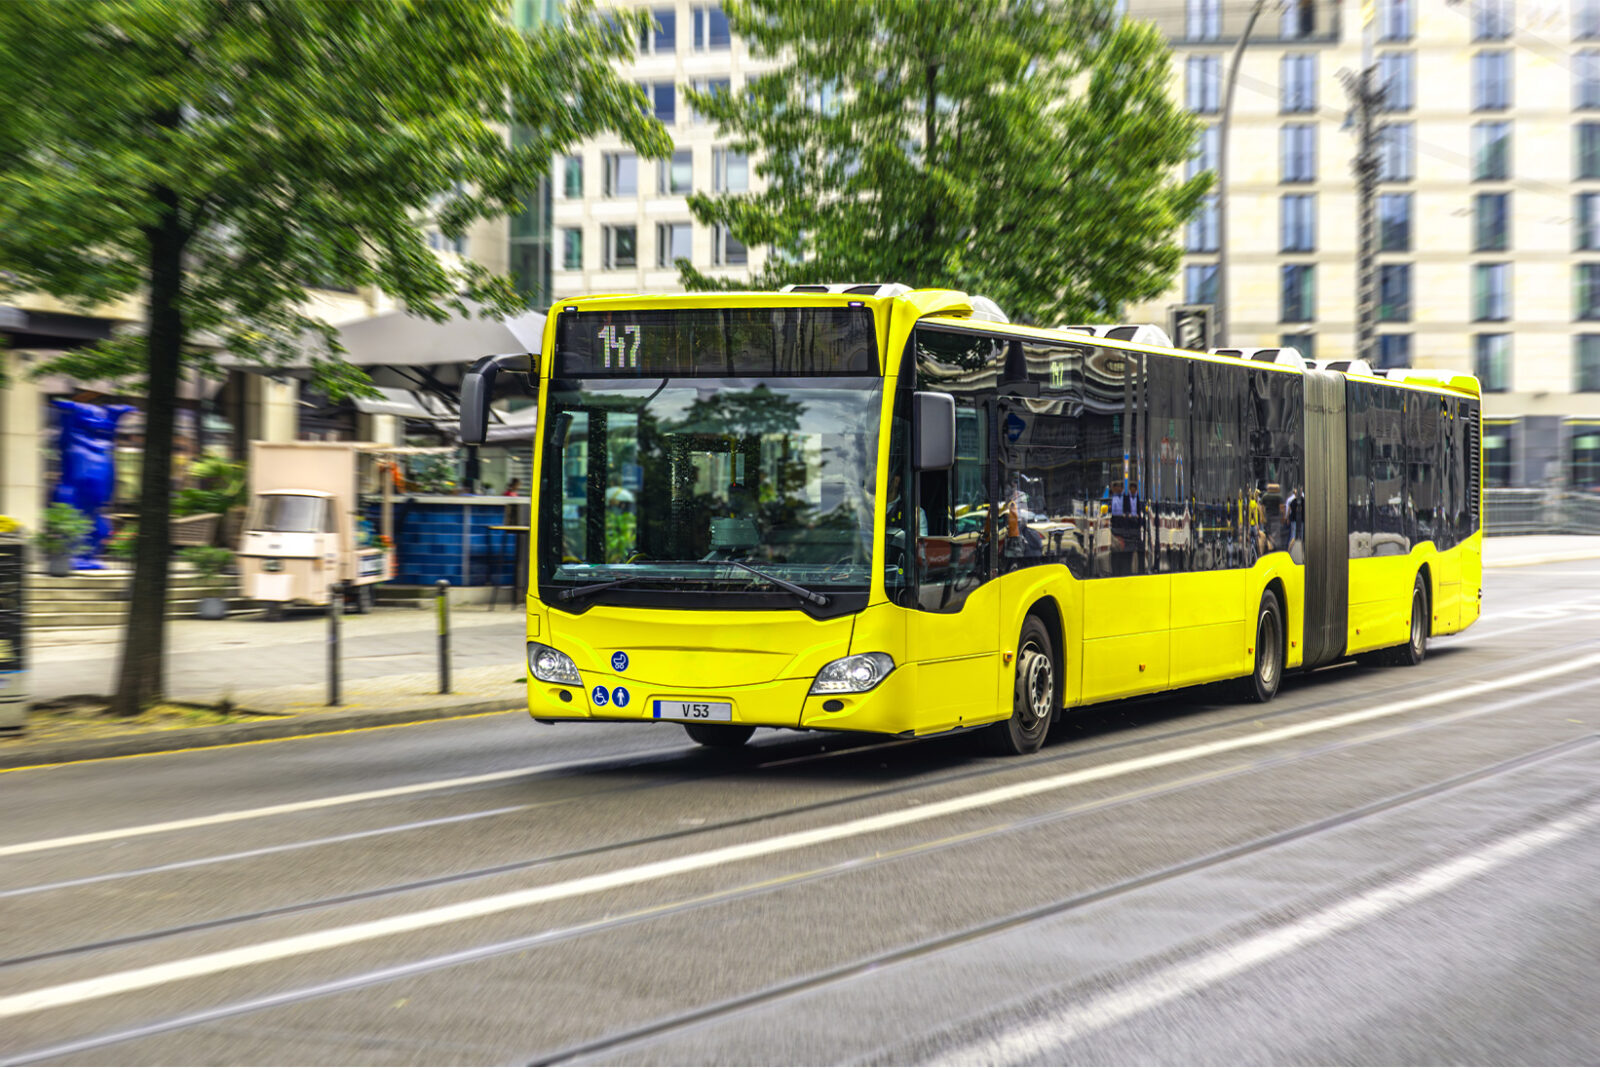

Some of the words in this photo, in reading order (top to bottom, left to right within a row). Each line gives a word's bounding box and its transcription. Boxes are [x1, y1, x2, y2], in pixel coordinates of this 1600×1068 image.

[598, 325, 640, 368] 147
[682, 703, 690, 717] V
[693, 704, 709, 718] 53
